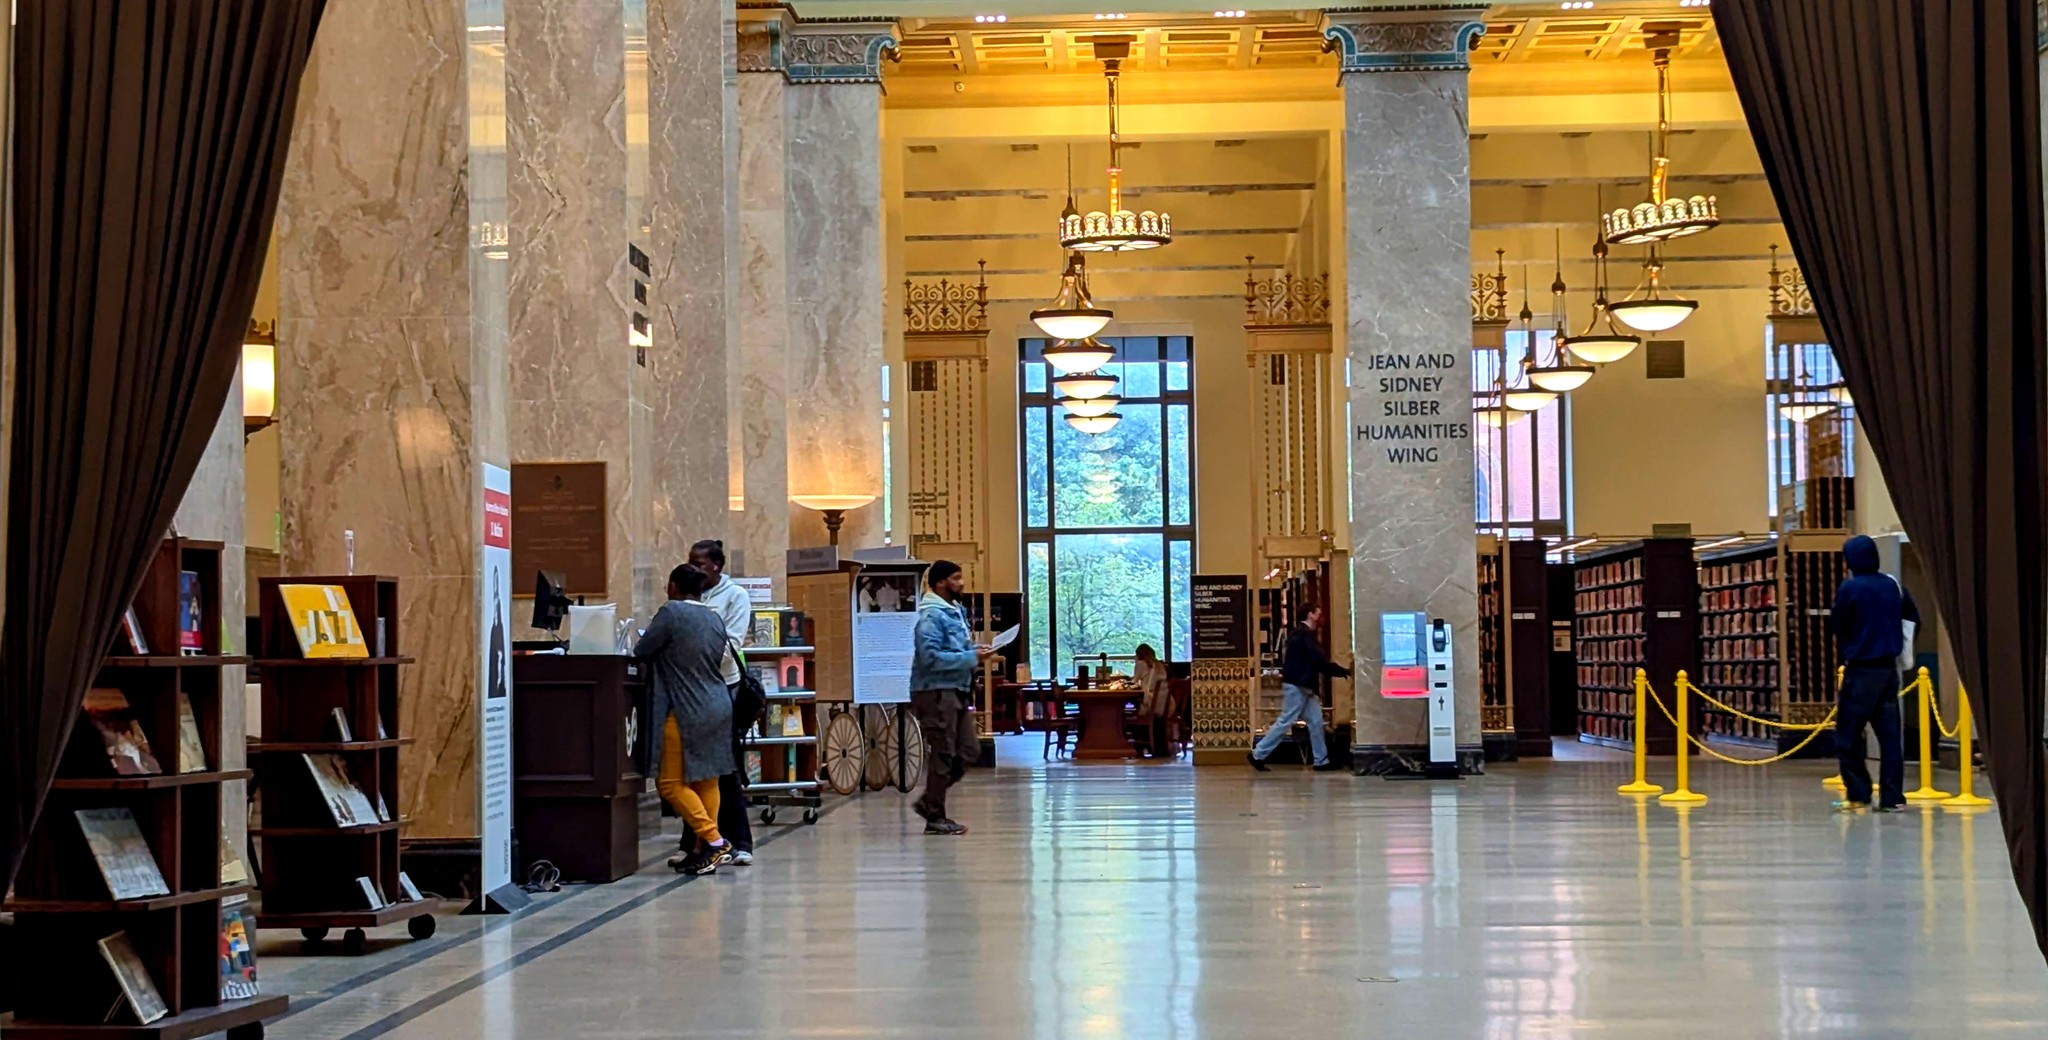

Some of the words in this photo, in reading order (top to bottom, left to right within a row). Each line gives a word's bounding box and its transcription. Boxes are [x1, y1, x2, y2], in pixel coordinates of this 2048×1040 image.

[1368, 354, 1410, 370] JEAN
[1415, 353, 1455, 369] AND
[1379, 377, 1443, 393] SIDNEY
[1384, 400, 1440, 416] SILBER
[1357, 423, 1468, 440] HUMANITIES
[1387, 447, 1438, 464] WING
